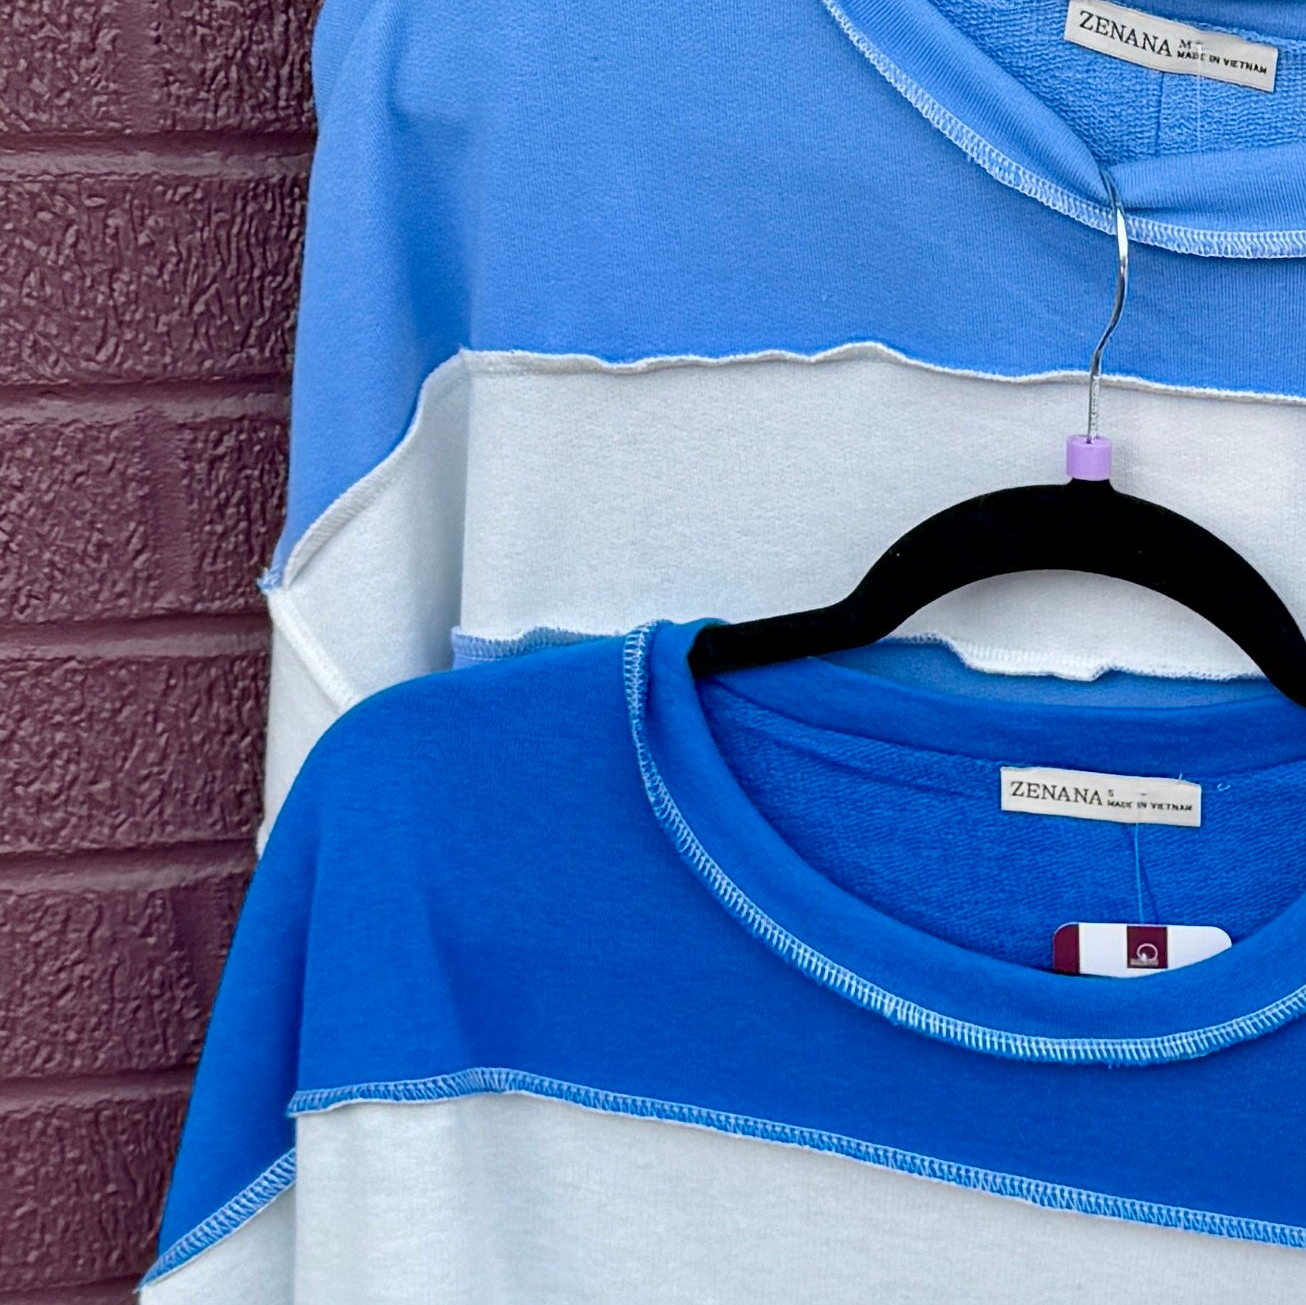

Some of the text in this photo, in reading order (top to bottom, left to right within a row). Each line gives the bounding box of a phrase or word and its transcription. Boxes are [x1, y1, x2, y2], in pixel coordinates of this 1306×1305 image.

[1079, 10, 1173, 58] ZENANA
[1177, 51, 1267, 74] MADE IN VIETNAM
[1010, 781, 1103, 806] ZENANA
[1107, 800, 1193, 811] MADE IN VIETNAM
